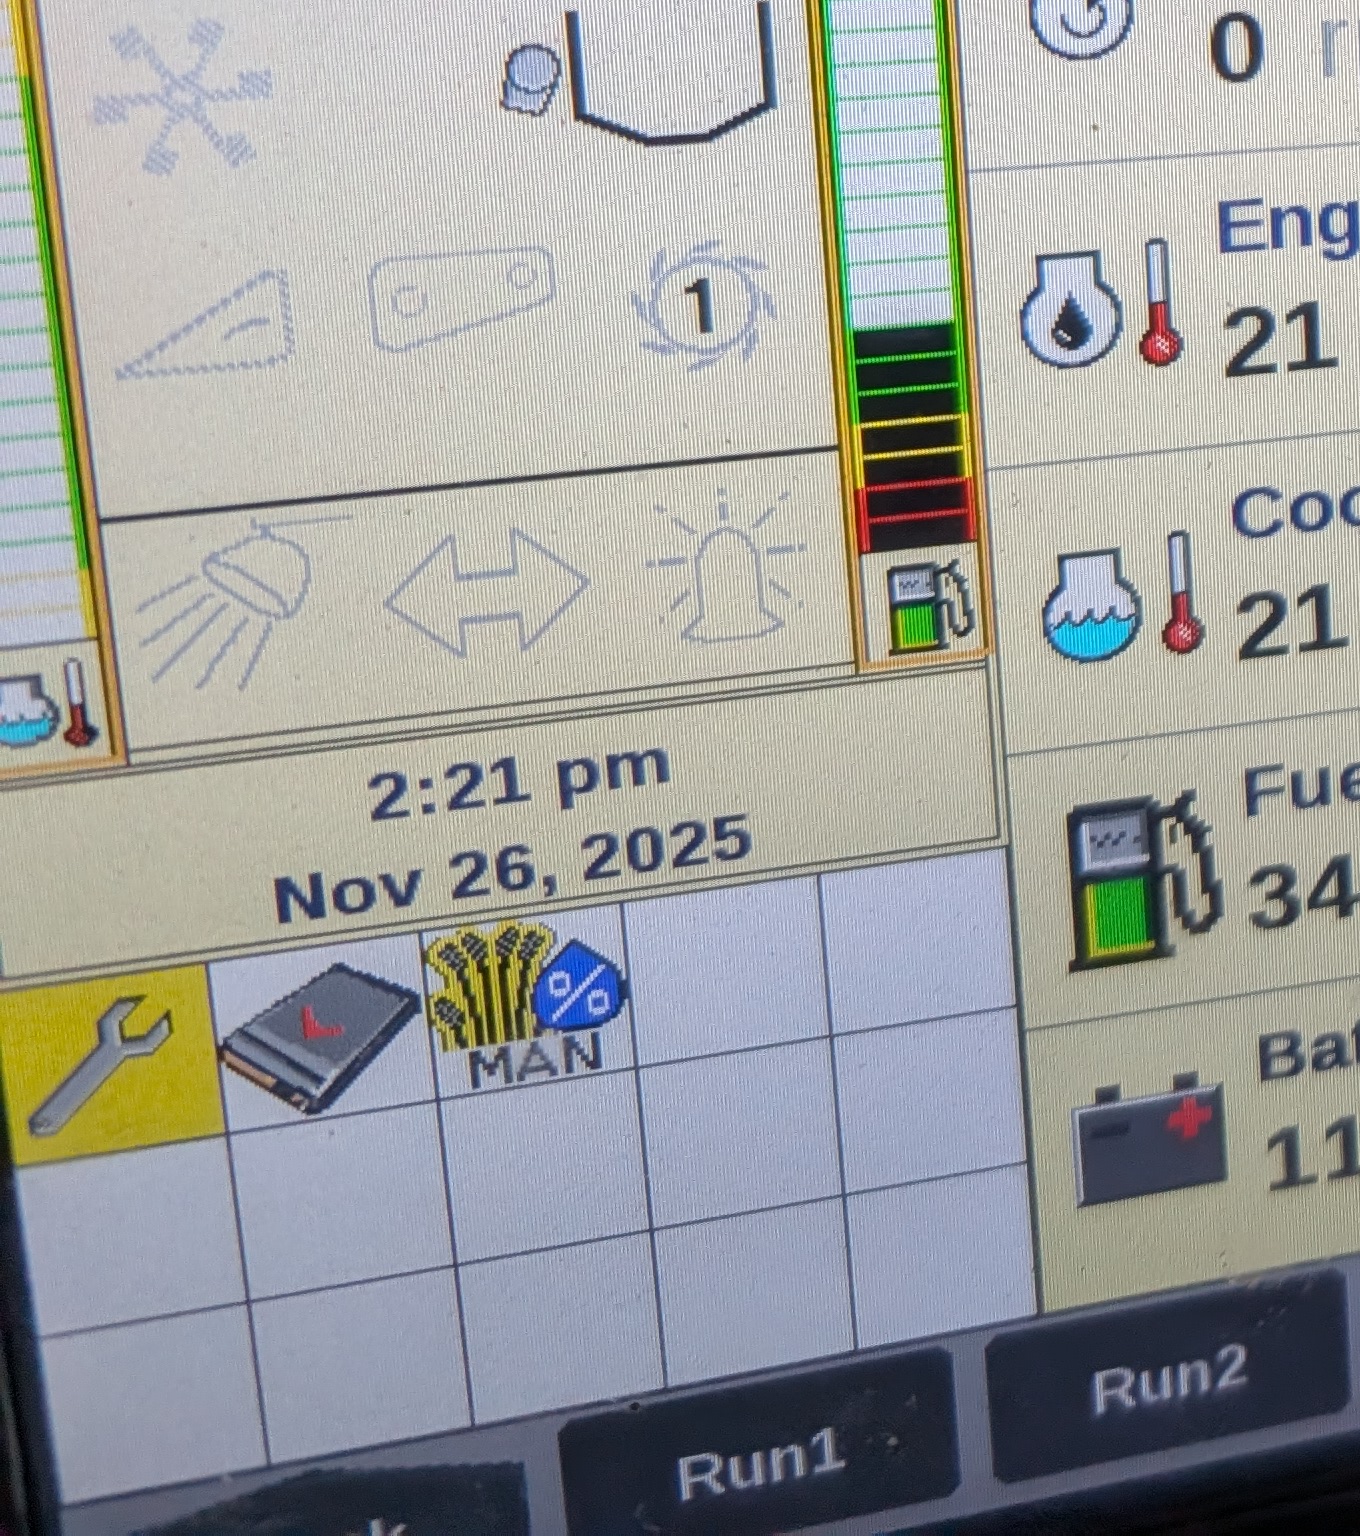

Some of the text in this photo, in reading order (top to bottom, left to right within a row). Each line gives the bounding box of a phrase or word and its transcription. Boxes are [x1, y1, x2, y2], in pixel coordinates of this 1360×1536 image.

[1211, 12, 1264, 82] 0
[684, 278, 713, 333] 1
[1225, 299, 1338, 377] 21
[1237, 582, 1350, 661] 21
[367, 745, 672, 820] 2:21 pm
[273, 814, 753, 924] Nov 26, 2025
[468, 1033, 602, 1089] MAN
[1092, 1344, 1248, 1416] Run2
[679, 1426, 847, 1500] Run1
